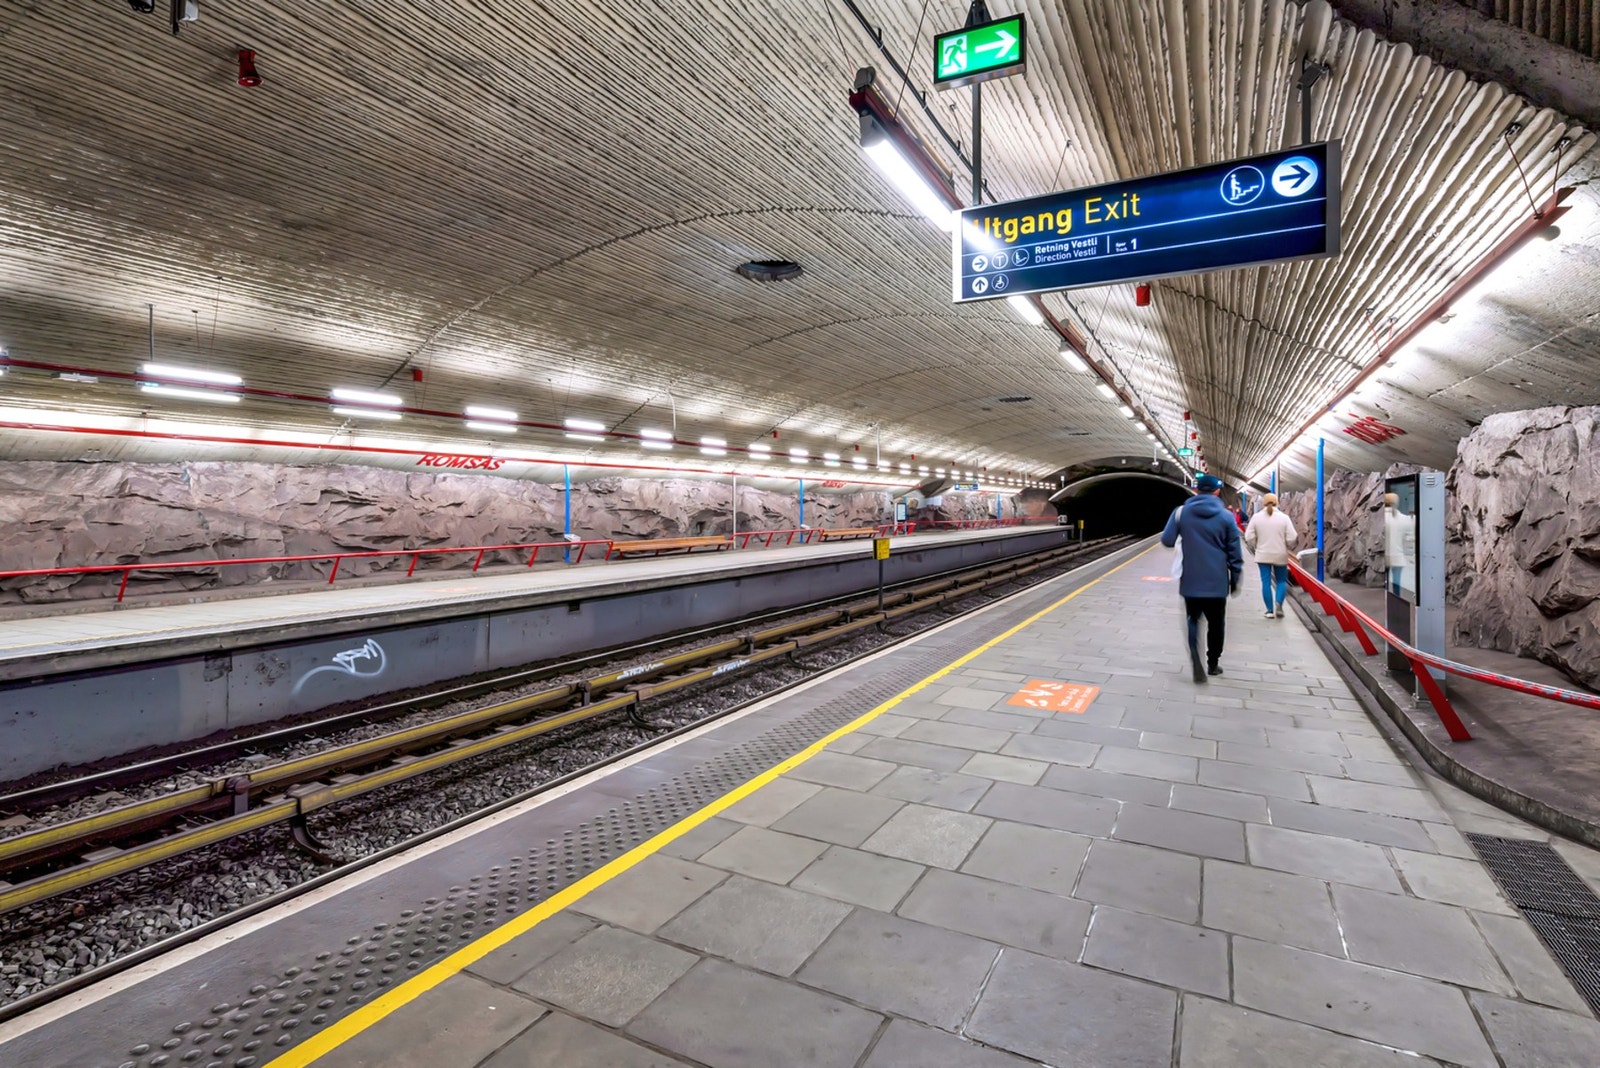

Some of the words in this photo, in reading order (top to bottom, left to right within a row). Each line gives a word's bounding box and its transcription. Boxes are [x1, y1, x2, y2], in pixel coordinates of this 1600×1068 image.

[1085, 193, 1141, 225] Exit
[1035, 243, 1069, 255] Retning
[1071, 237, 1098, 249] Vestli
[1131, 238, 1137, 250] 1
[1035, 252, 1072, 264] Direction
[1073, 247, 1097, 258] Vestli
